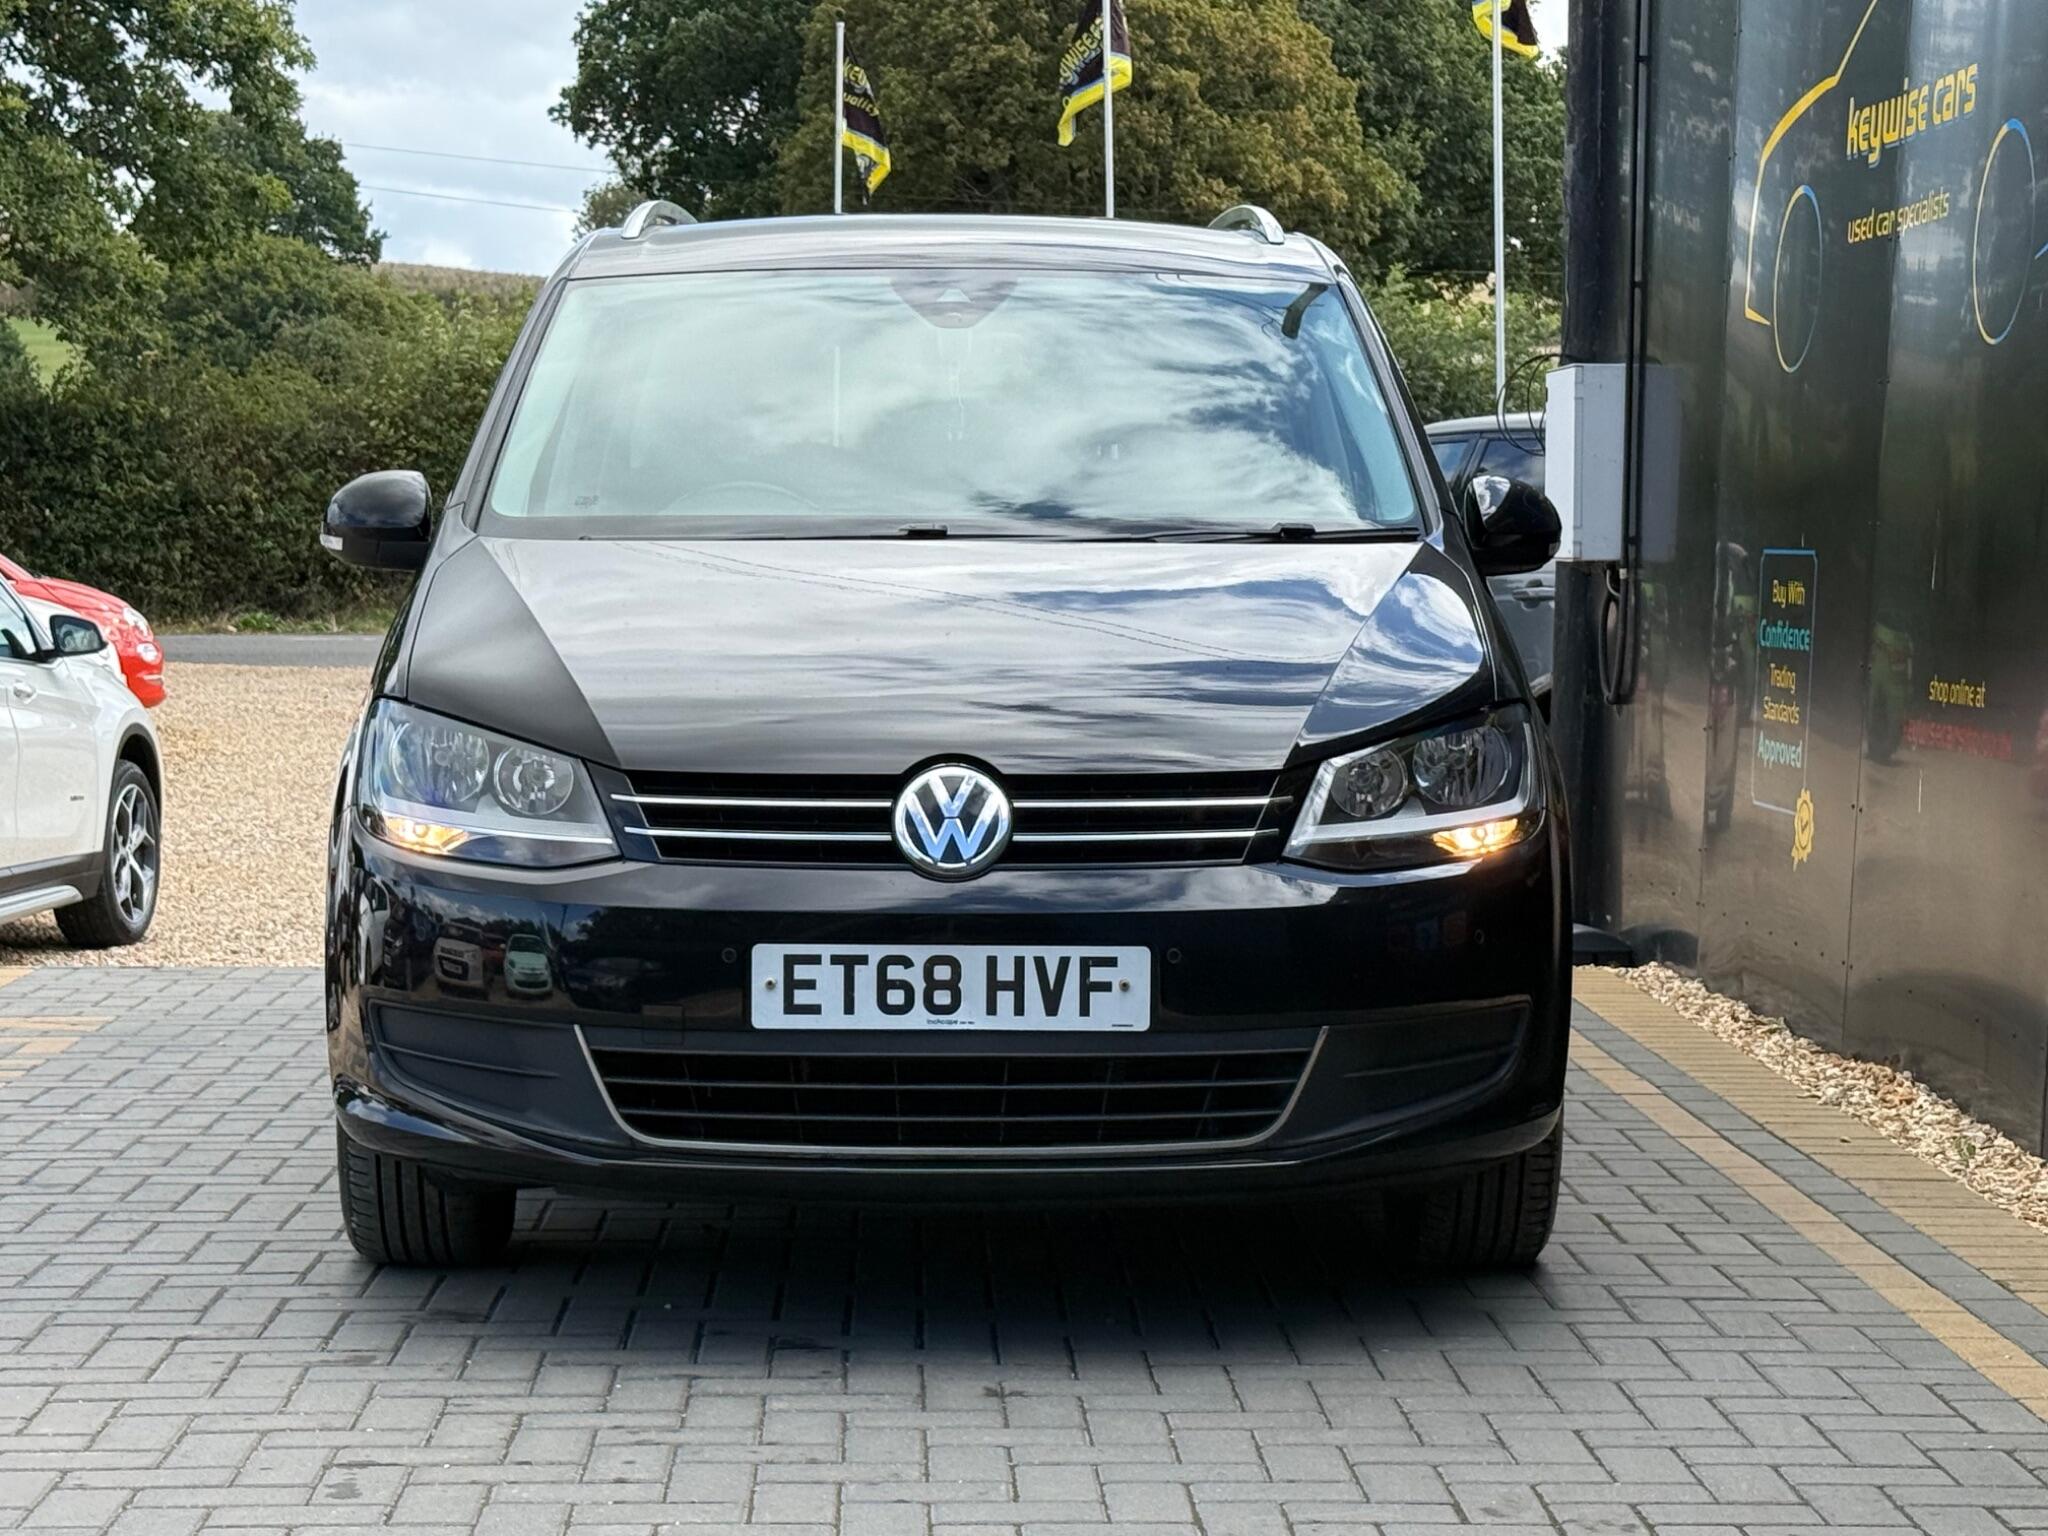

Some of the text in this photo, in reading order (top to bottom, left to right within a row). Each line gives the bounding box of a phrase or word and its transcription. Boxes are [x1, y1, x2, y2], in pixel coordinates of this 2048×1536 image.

[1846, 63, 1978, 166] keywise cars
[1847, 186, 1950, 244] used car specialists
[1773, 579, 1805, 608] Buy With
[1760, 618, 1810, 652] Confidence
[1769, 663, 1796, 695] Trading
[1929, 673, 1986, 708] shop online at
[1763, 695, 1800, 725] Standards
[1757, 729, 1803, 769] Approved
[783, 954, 1118, 1018] ET68 HVF
